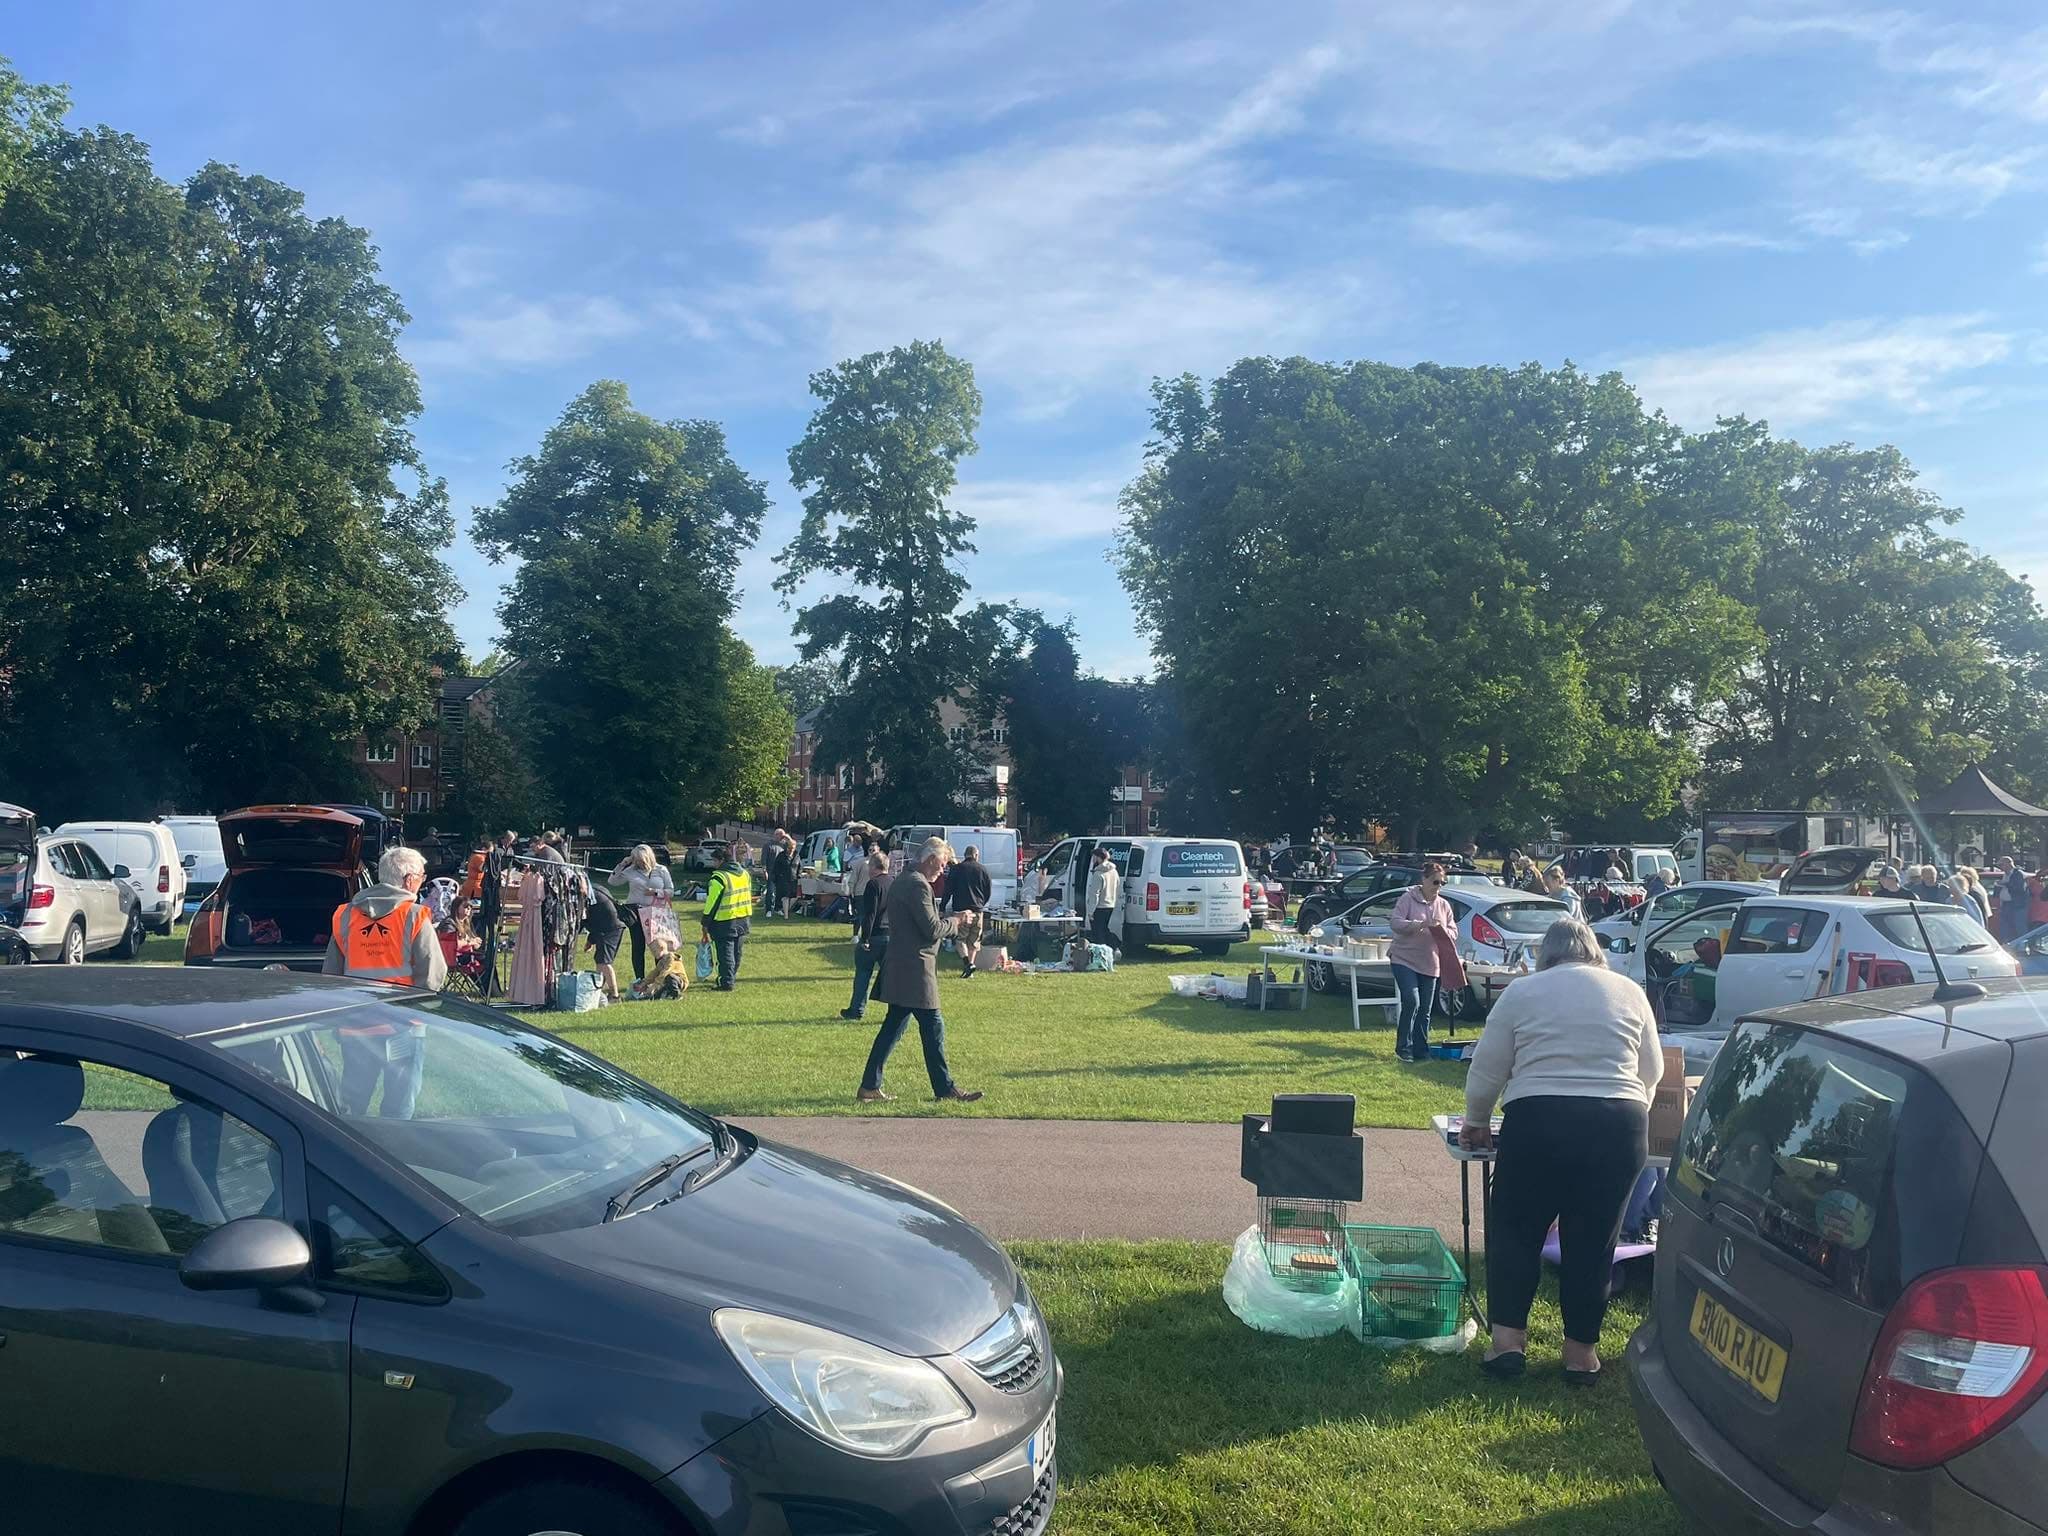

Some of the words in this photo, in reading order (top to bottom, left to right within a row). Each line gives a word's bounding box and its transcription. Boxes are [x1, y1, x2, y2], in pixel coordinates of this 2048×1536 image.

[1181, 851, 1224, 861] Cleantech
[1699, 1298, 1730, 1353] BK10
[1731, 1325, 1774, 1385] RAU
